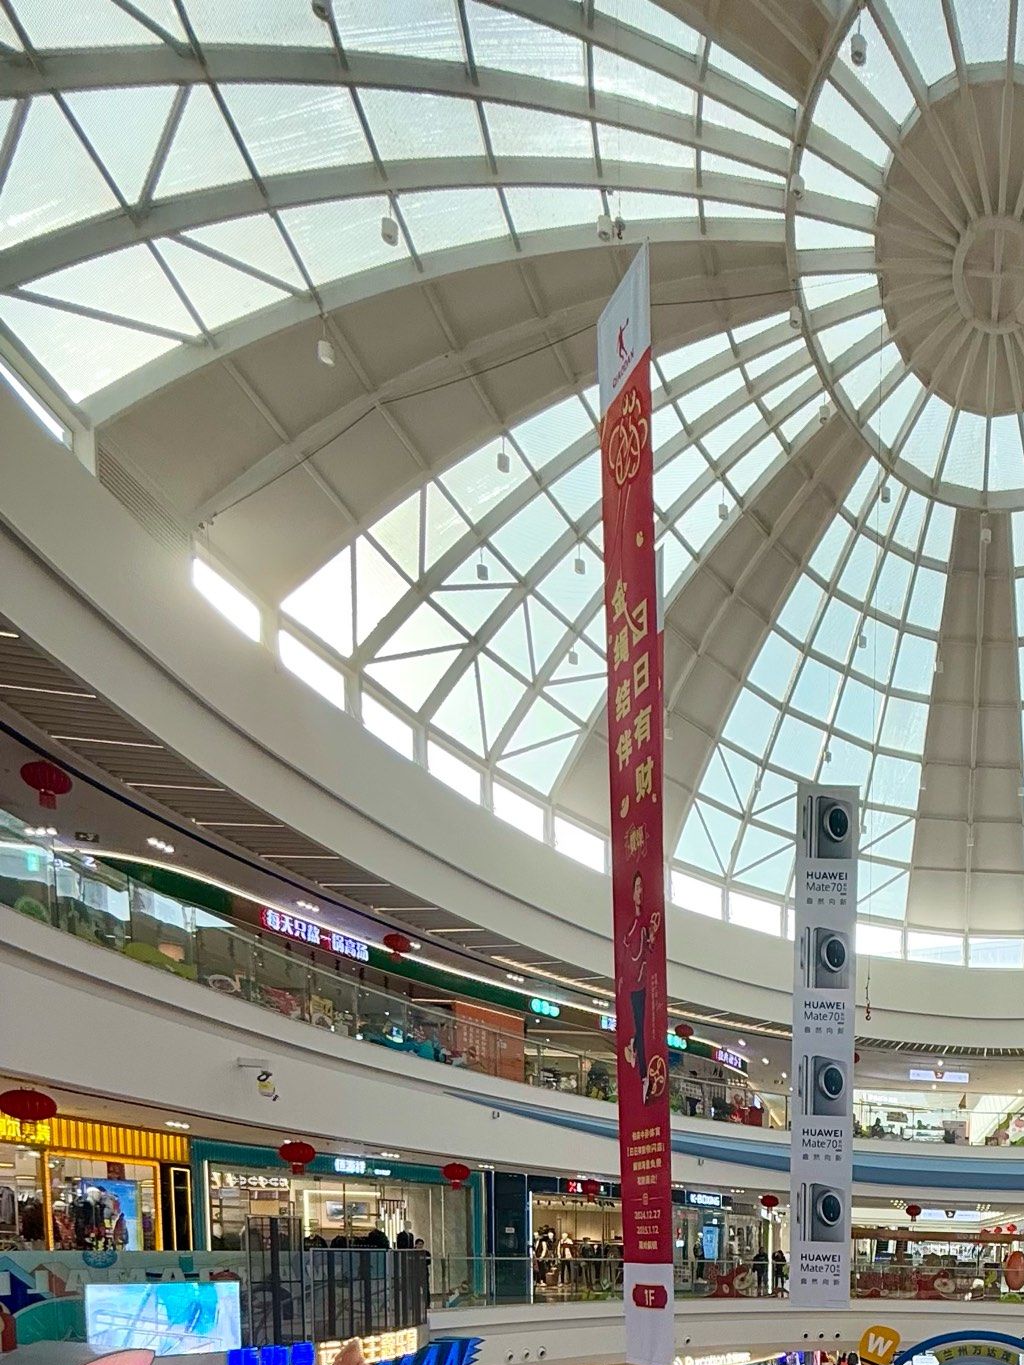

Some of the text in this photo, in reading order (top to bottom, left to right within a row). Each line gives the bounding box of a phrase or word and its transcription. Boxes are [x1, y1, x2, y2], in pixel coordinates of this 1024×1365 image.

[806, 871, 848, 881] HUAWEI
[265, 909, 370, 962] 每天只熬一锅高汤
[804, 1001, 845, 1010] HUAWEI
[802, 1128, 843, 1138] HUAWEI
[800, 1253, 841, 1263] HUAWEI
[644, 1289, 655, 1306] 1F
